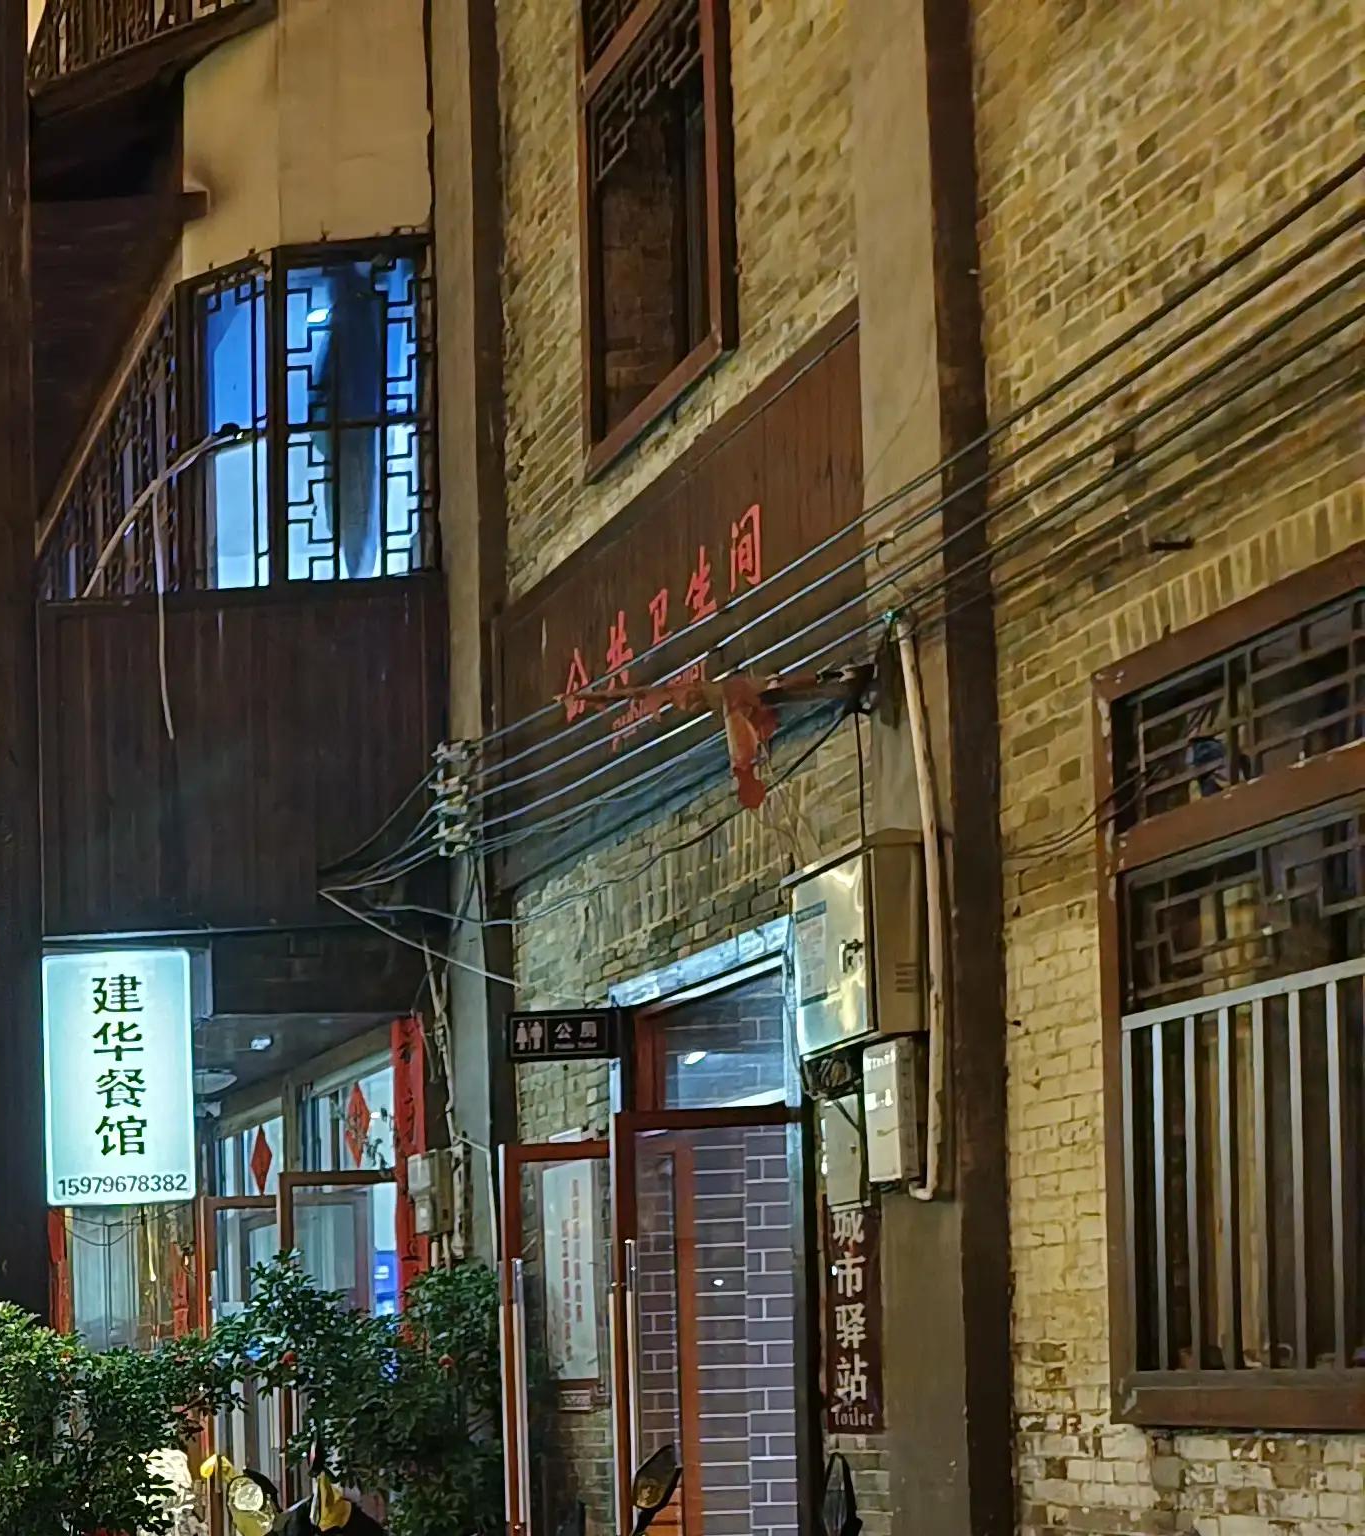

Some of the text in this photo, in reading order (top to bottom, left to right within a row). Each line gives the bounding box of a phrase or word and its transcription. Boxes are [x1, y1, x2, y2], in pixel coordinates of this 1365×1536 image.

[565, 503, 762, 723] 公共卫生间
[91, 973, 148, 1157] 建华餐馆
[56, 1173, 189, 1198] 15979678382
[832, 1210, 870, 1402] 城市驿站
